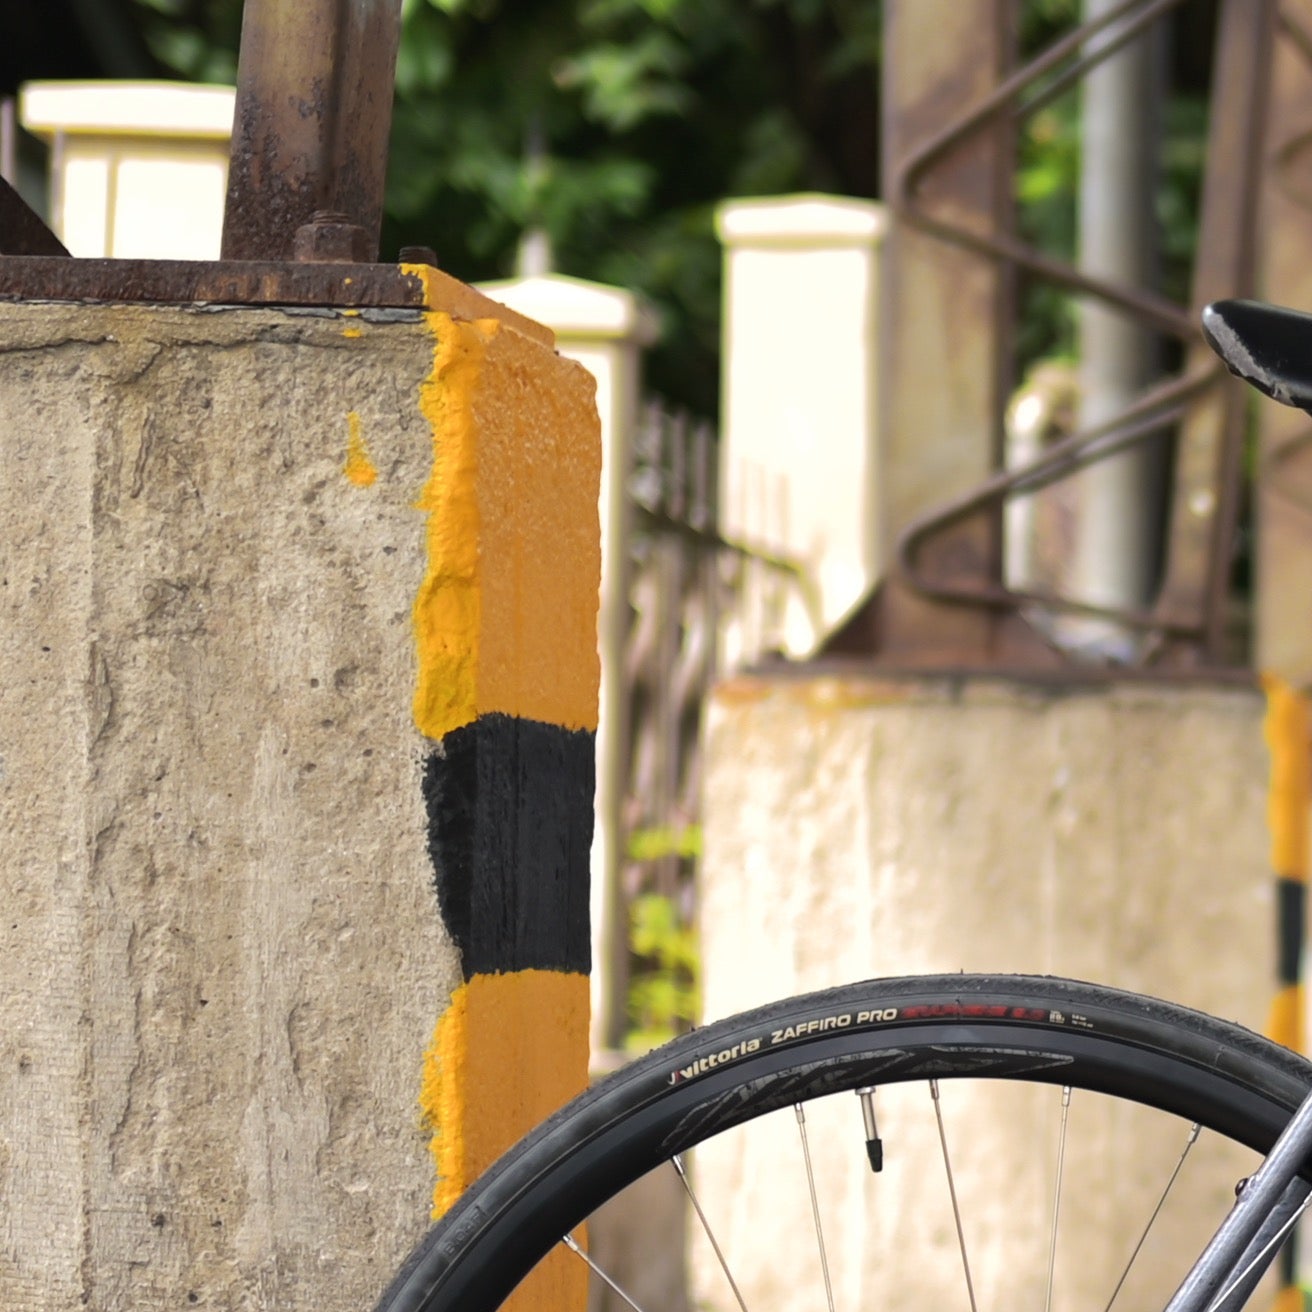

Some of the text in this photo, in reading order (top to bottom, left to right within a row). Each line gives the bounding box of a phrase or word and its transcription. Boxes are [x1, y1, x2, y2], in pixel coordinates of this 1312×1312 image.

[679, 1037, 760, 1079] vittoria
[771, 1013, 852, 1044] ZAFFIRO
[856, 1008, 898, 1023] PRO
